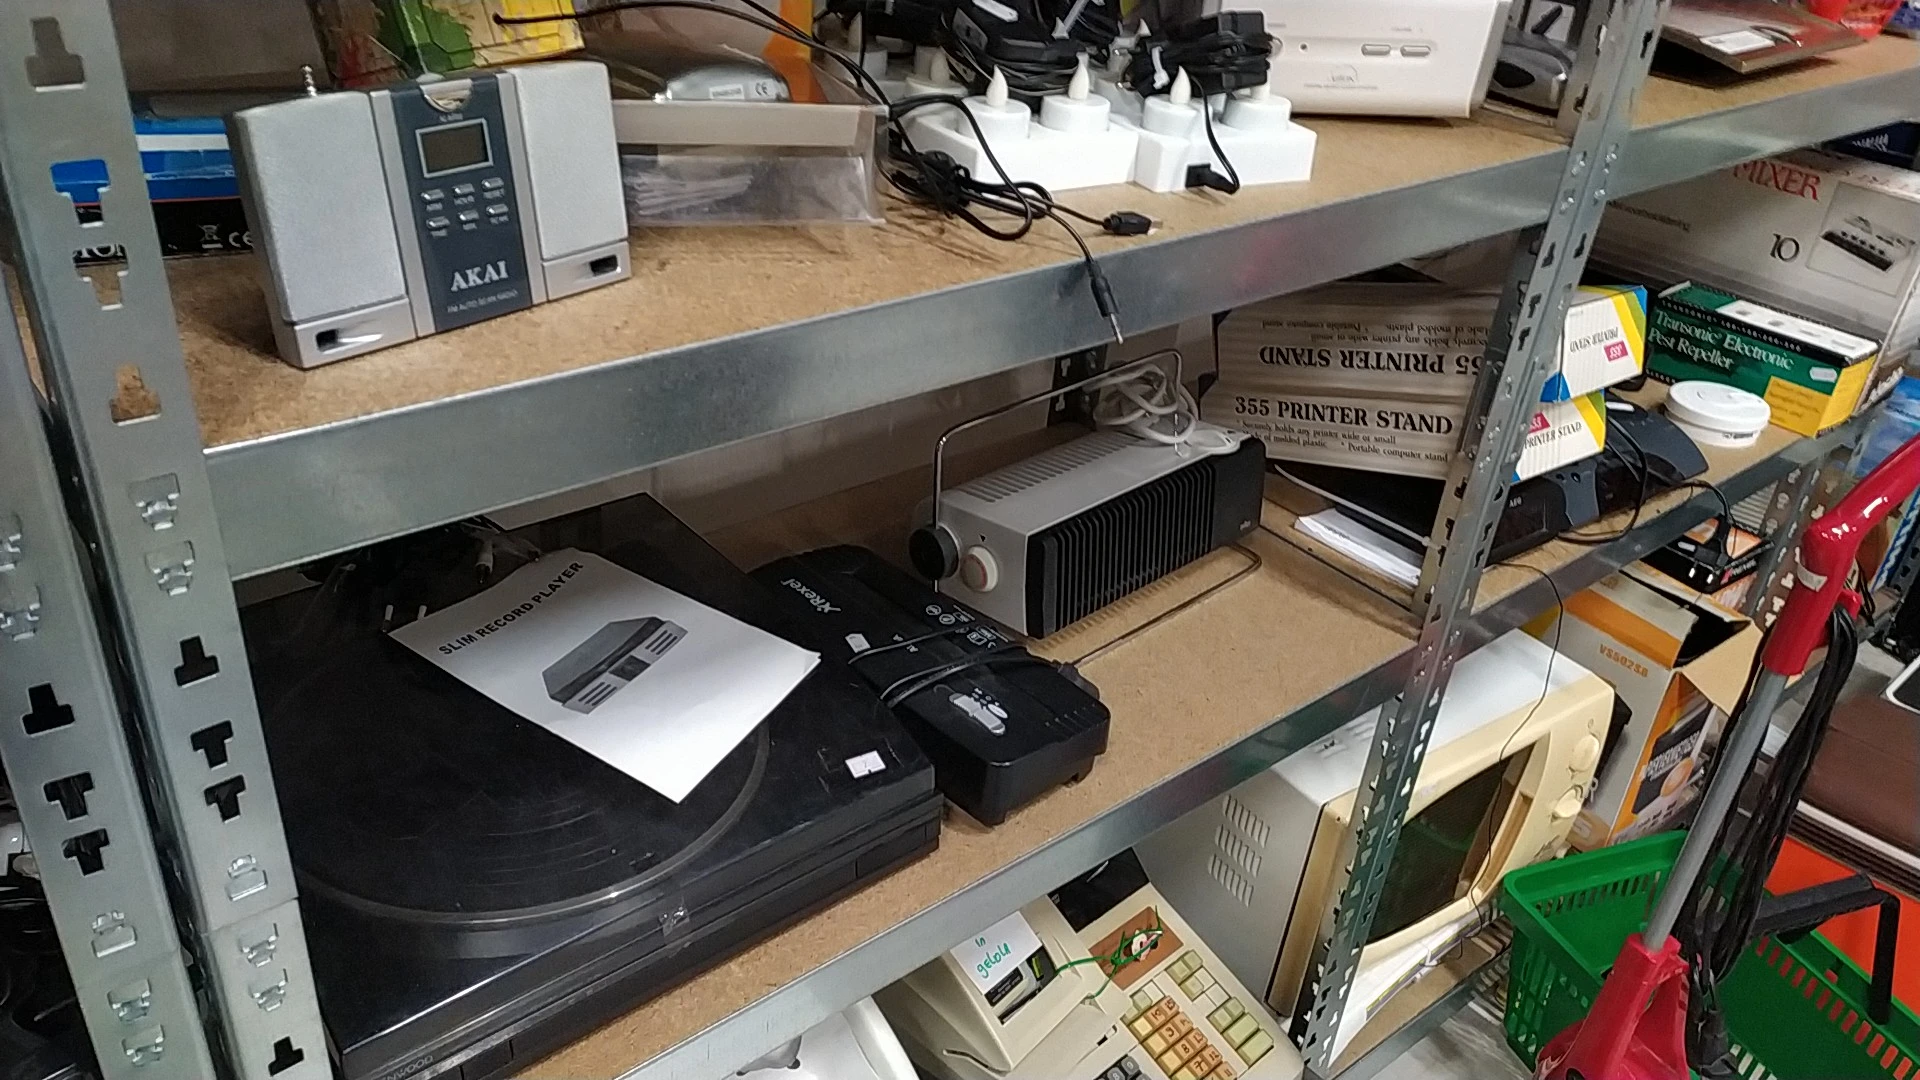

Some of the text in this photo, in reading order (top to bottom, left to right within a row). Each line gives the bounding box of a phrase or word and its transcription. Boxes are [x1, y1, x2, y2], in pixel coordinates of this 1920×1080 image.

[451, 260, 508, 292] AKAI
[1259, 346, 1484, 376] 55 PRINTER STAND
[1648, 327, 1736, 372] Pest Repeller
[1723, 333, 1794, 371] Electronic
[1235, 396, 1453, 434] 355 PRINTER STAND
[438, 562, 584, 655] SLIM RECORD PLAYER
